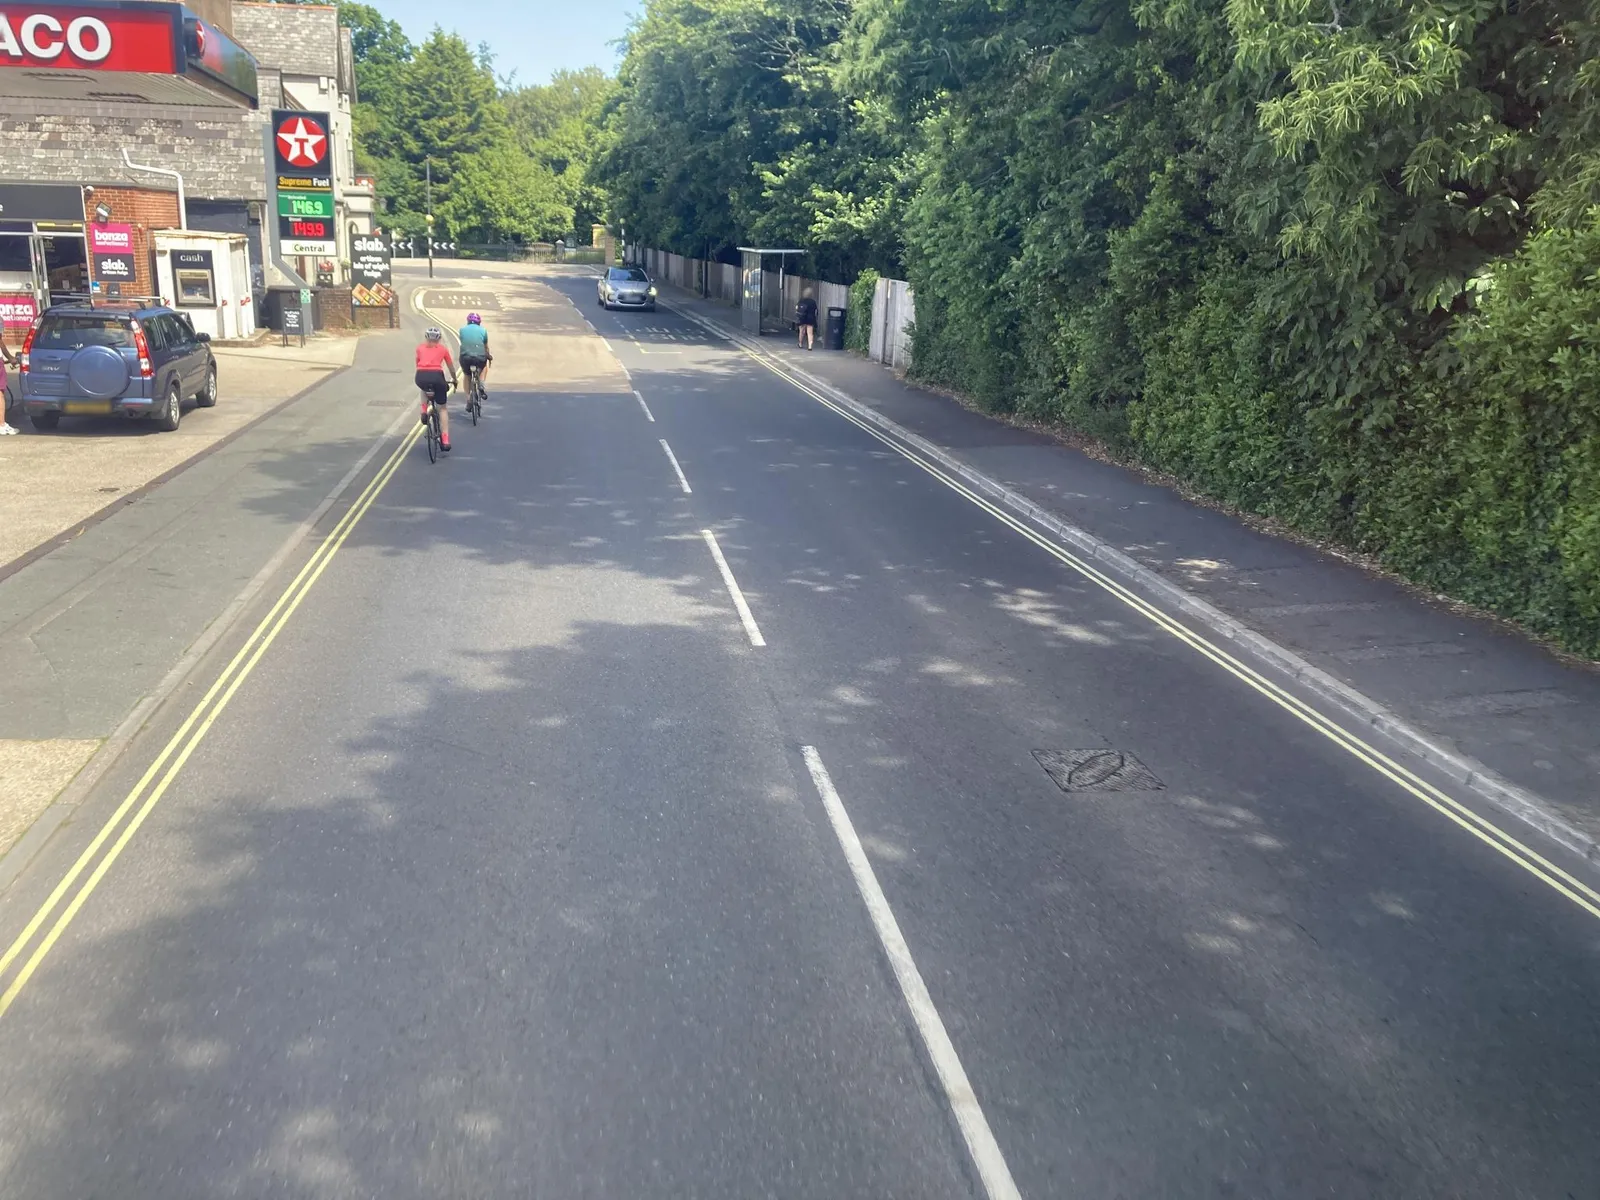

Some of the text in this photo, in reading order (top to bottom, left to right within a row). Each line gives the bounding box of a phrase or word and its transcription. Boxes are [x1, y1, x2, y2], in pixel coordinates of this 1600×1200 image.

[279, 176, 330, 187] Supreme Fuel
[292, 200, 323, 215] 146.9
[94, 229, 128, 241] bonza
[293, 222, 325, 236] 149.9
[294, 244, 325, 252] Central
[354, 237, 387, 251] slab.
[180, 253, 204, 262] cash
[101, 258, 128, 270] slab.
